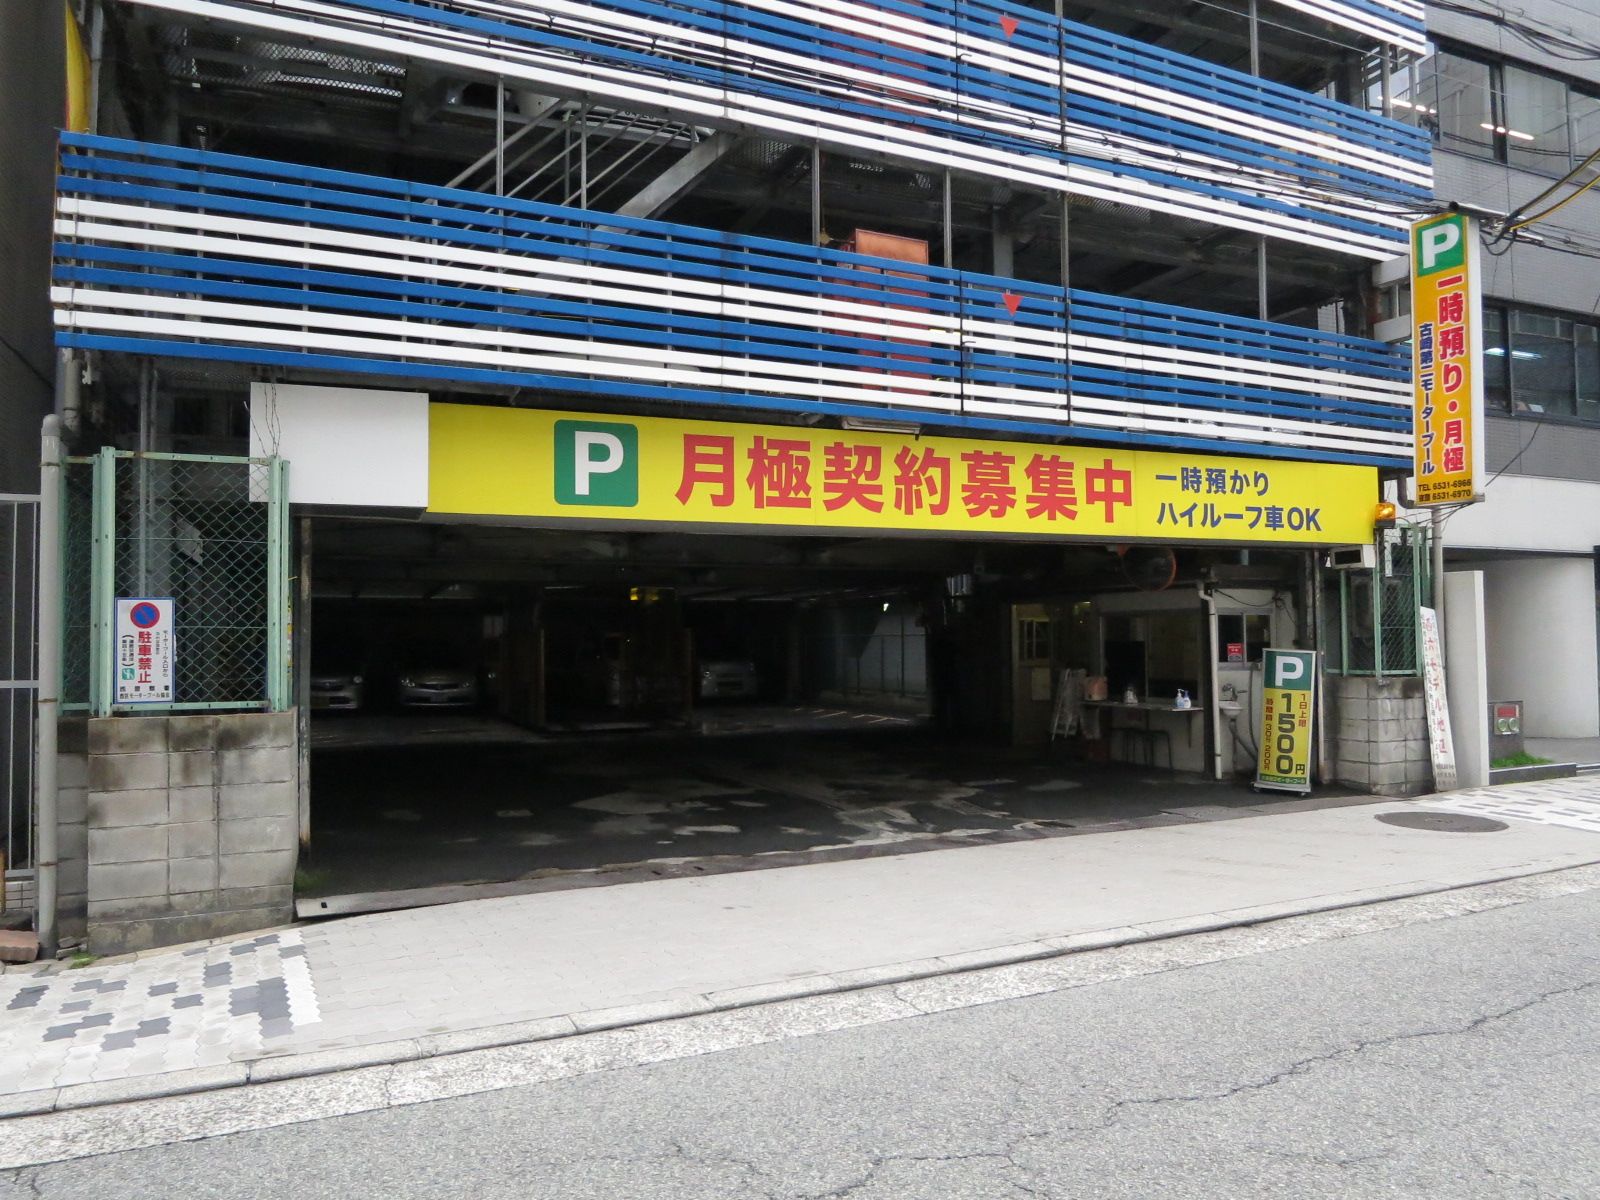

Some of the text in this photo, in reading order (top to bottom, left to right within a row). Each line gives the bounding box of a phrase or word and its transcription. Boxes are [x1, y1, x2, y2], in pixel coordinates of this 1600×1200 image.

[1421, 224, 1460, 268] P
[1437, 275, 1466, 473] 一時預り・月極
[574, 430, 625, 496] P
[675, 432, 1133, 524] 月極契約募集中
[1155, 467, 1270, 498] 一時預かり
[1418, 484, 1431, 492] TEL
[1156, 503, 1323, 533] ハイルーフ車OK
[137, 631, 152, 684] 駐車禁止
[1275, 655, 1304, 687] P
